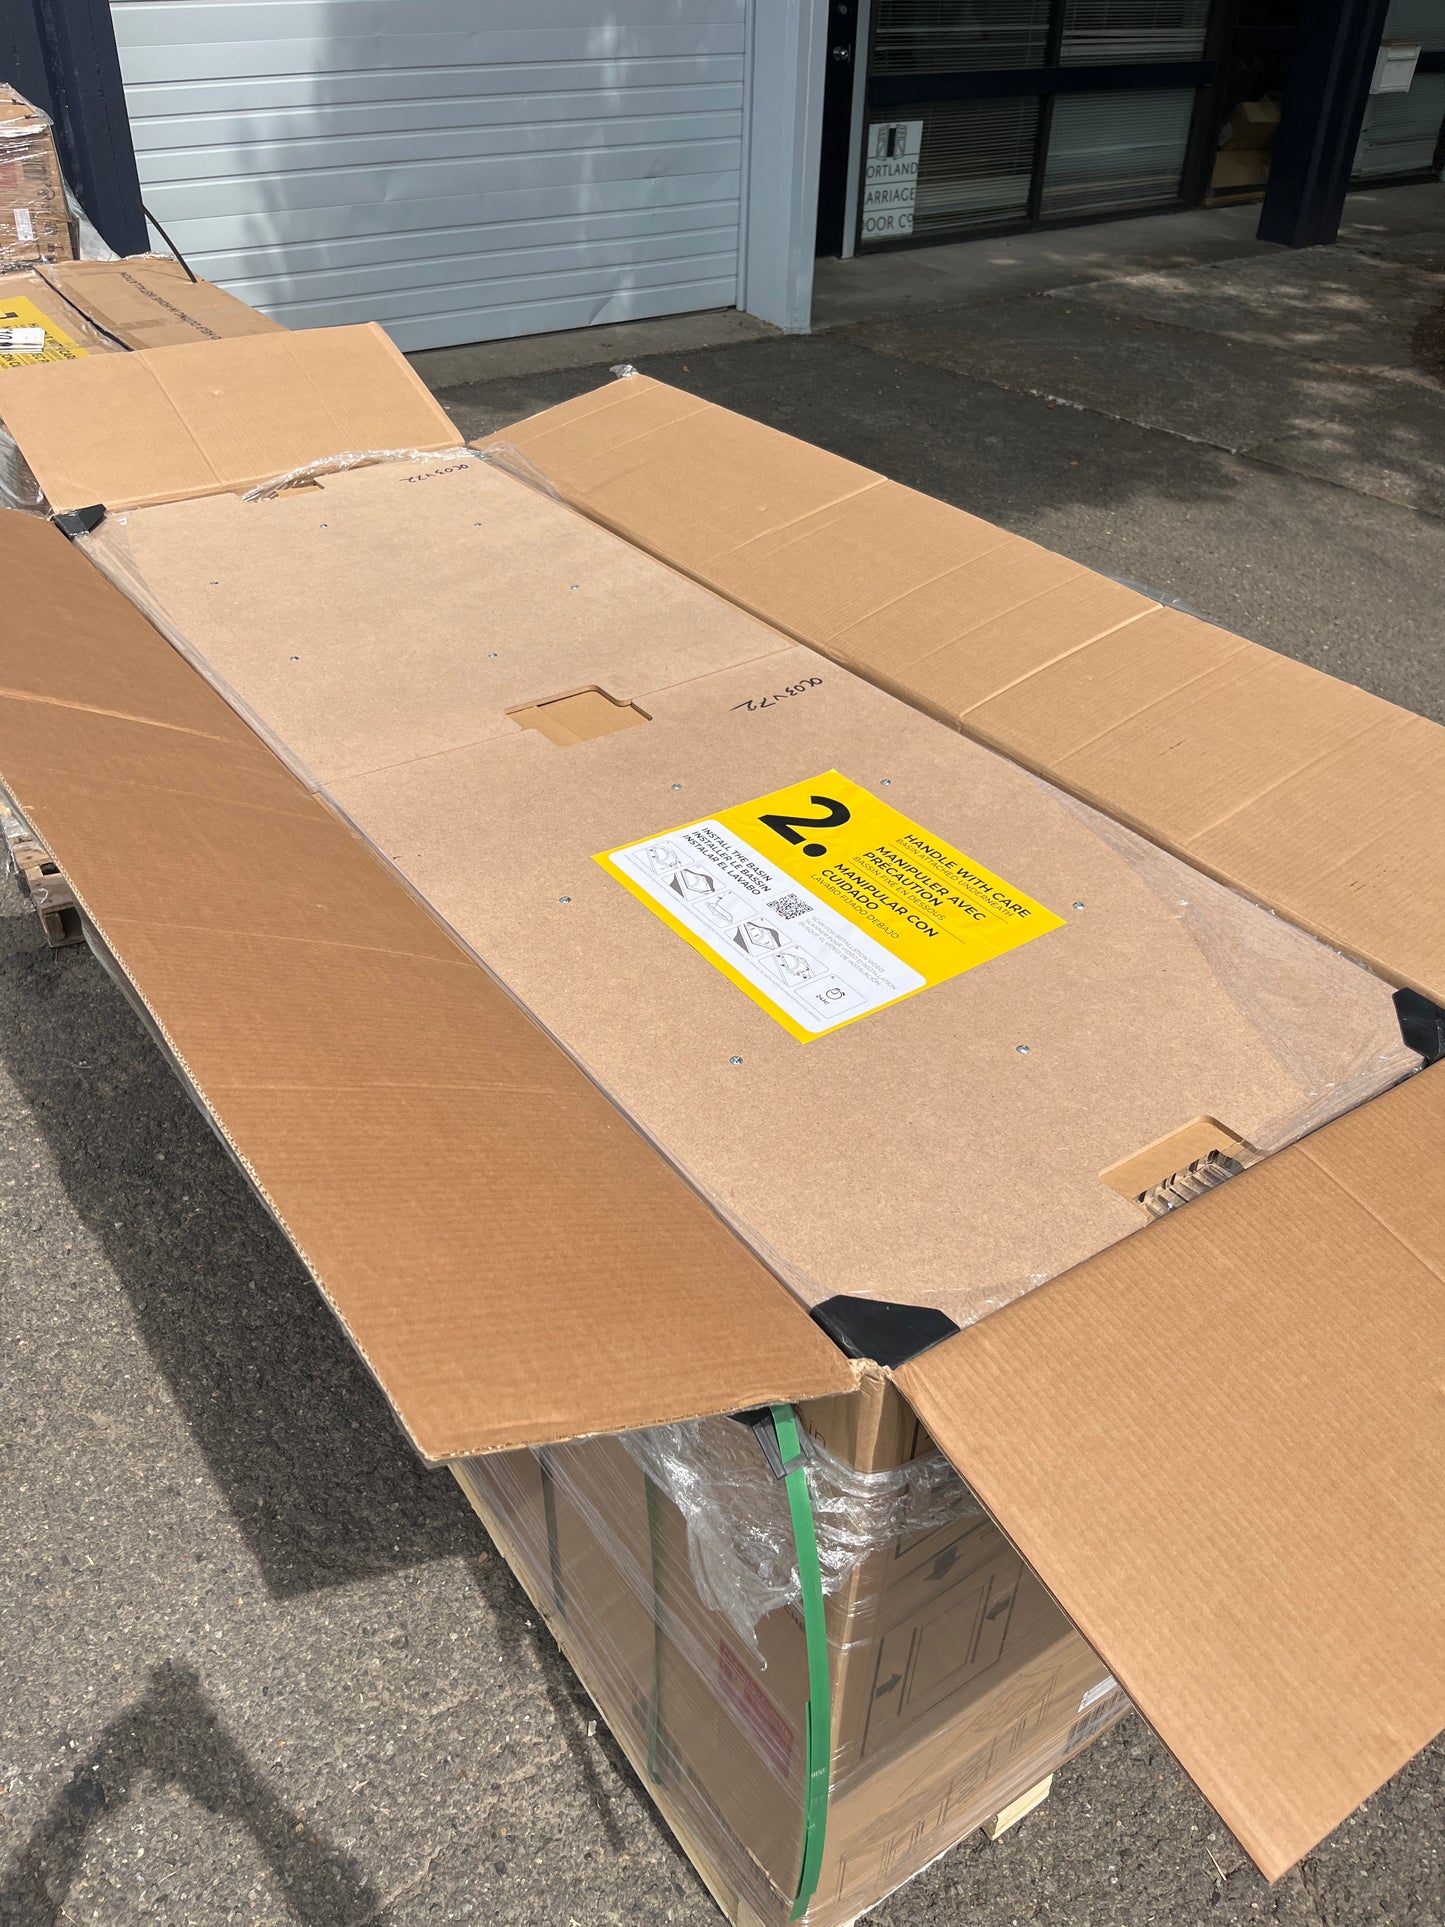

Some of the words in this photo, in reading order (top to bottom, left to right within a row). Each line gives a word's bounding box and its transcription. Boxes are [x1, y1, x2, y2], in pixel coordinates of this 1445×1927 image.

[865, 187, 915, 204] ARRIAGE
[866, 162, 917, 178] ORTLAND
[681, 834, 720, 862] INSTALAR
[715, 861, 731, 870] EL
[725, 869, 762, 895] LAVABO
[690, 830, 733, 861] INSTALLER
[728, 860, 743, 869] LE
[739, 868, 772, 892] BASSIN
[700, 827, 734, 851] INSTALL
[729, 849, 749, 863] THE
[744, 862, 773, 881] BASIN
[861, 850, 946, 907] PRÉCAUTION
[874, 846, 950, 896] MANIPULER
[945, 894, 987, 921] AVEC
[894, 838, 921, 854] BASIN
[916, 853, 960, 881] ATTACHED
[956, 880, 1014, 917] UNDERNEATH
[902, 834, 958, 869] HANDLE
[952, 867, 994, 893] WITH
[989, 891, 1032, 918] CARE
[809, 873, 842, 896] LAVABO
[838, 894, 869, 915] FIJADO
[864, 914, 901, 939] DEBAJO
[819, 868, 880, 911] CUIDADO
[832, 863, 909, 915] MANIPULAR
[903, 913, 940, 937] CON
[851, 856, 882, 875] BASSIN
[895, 886, 910, 895] EN
[906, 894, 947, 921] DESSOUS
